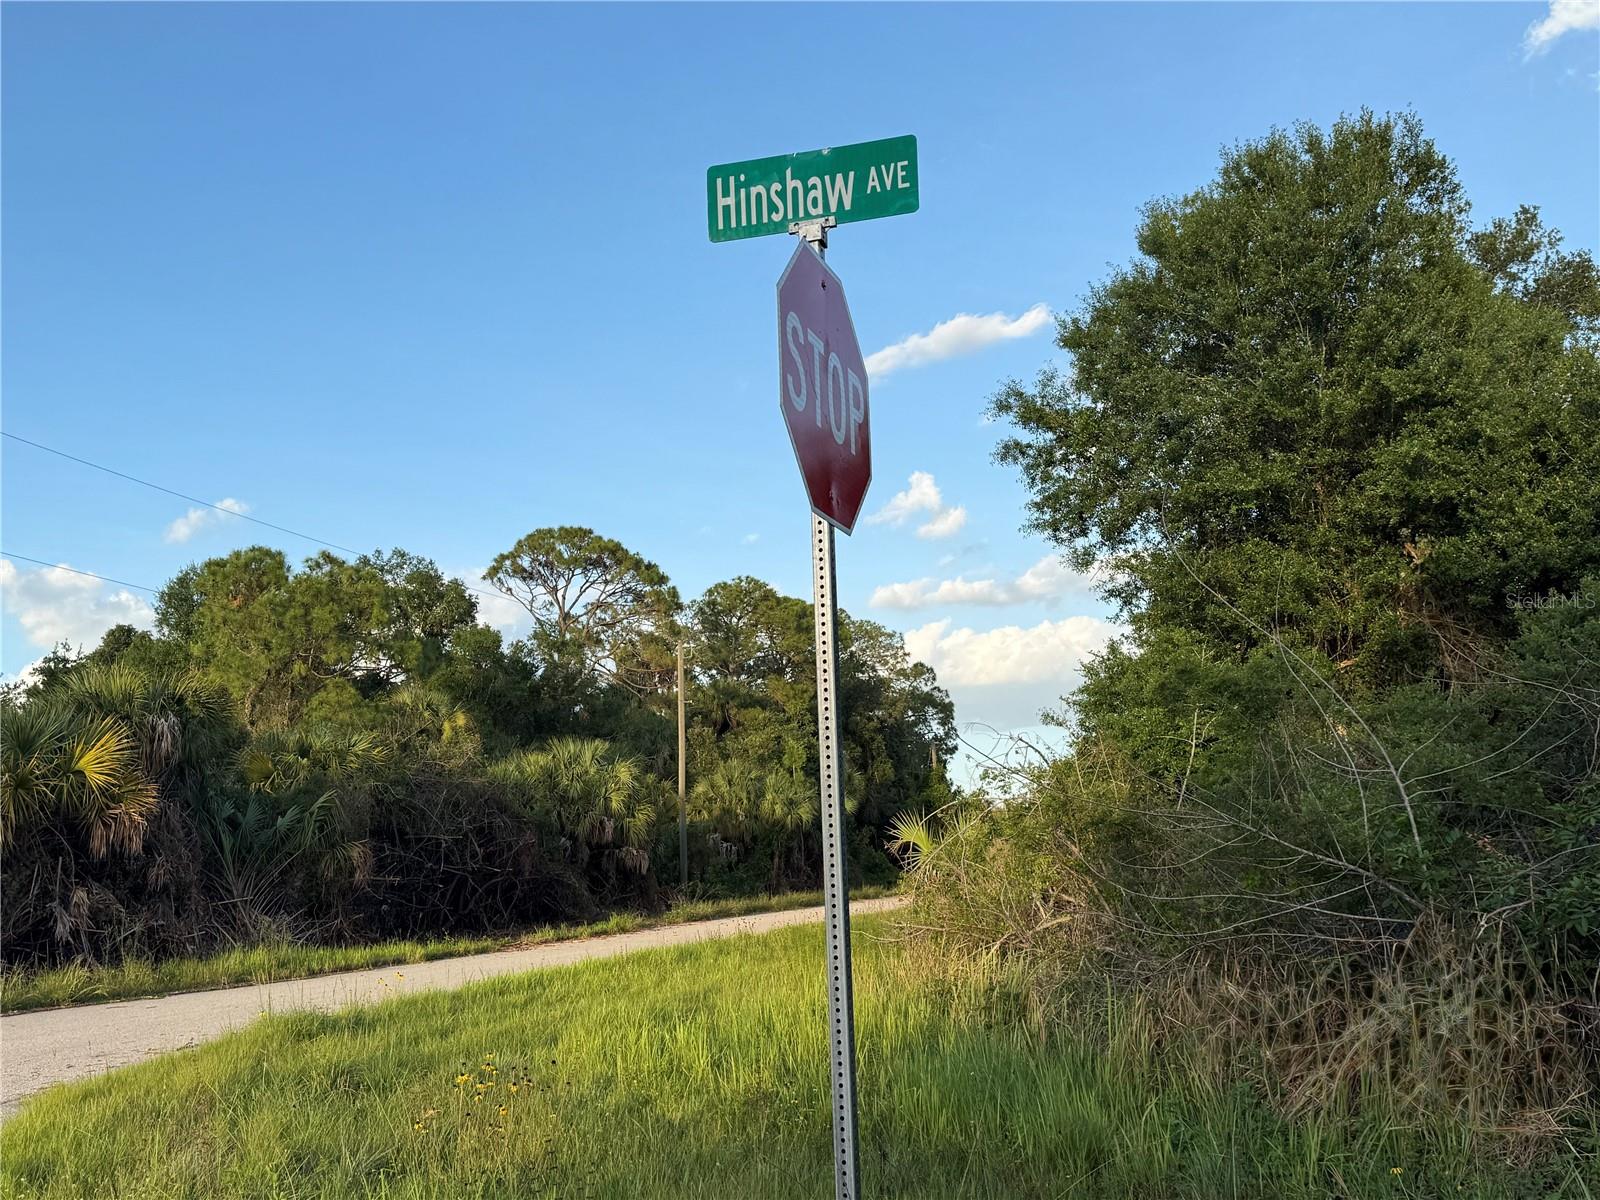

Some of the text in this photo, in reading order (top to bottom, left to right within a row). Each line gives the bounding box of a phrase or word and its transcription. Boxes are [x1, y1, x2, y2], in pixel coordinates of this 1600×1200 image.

[716, 160, 911, 230] Hinshaw AVE
[786, 311, 865, 456] STOP
